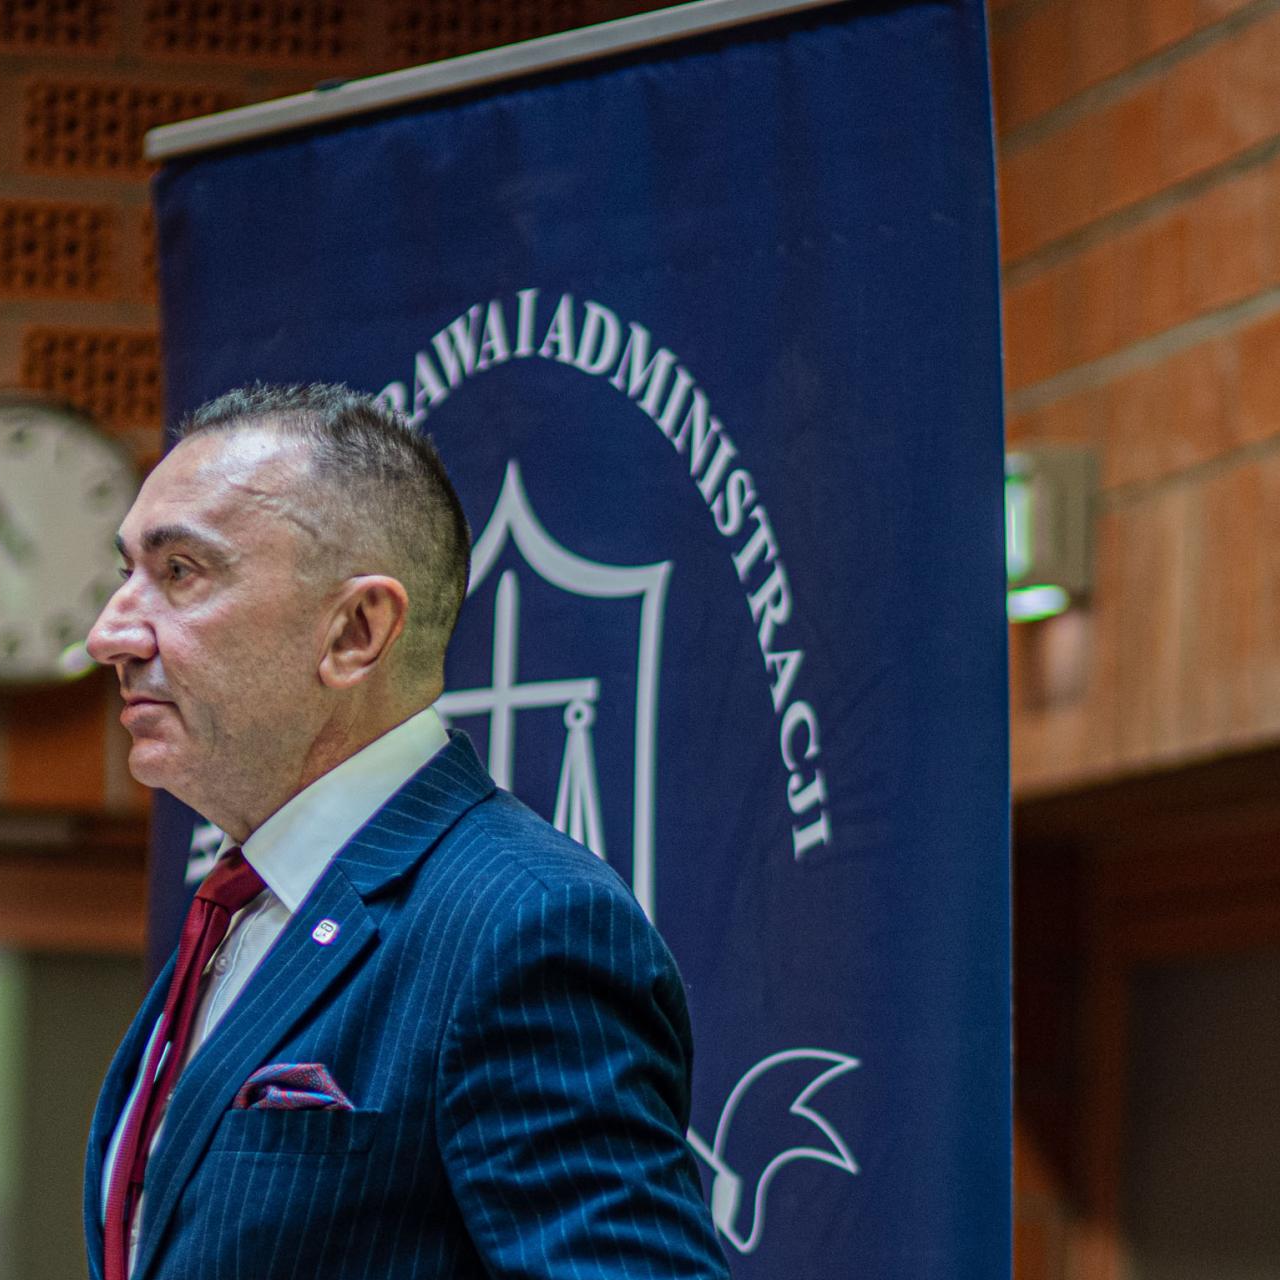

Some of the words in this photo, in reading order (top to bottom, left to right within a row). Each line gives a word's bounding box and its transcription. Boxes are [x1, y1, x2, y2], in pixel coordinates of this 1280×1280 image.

[369, 299, 510, 428] RAWA
[515, 286, 540, 358] I
[538, 292, 832, 862] ADMINISTRACJI
